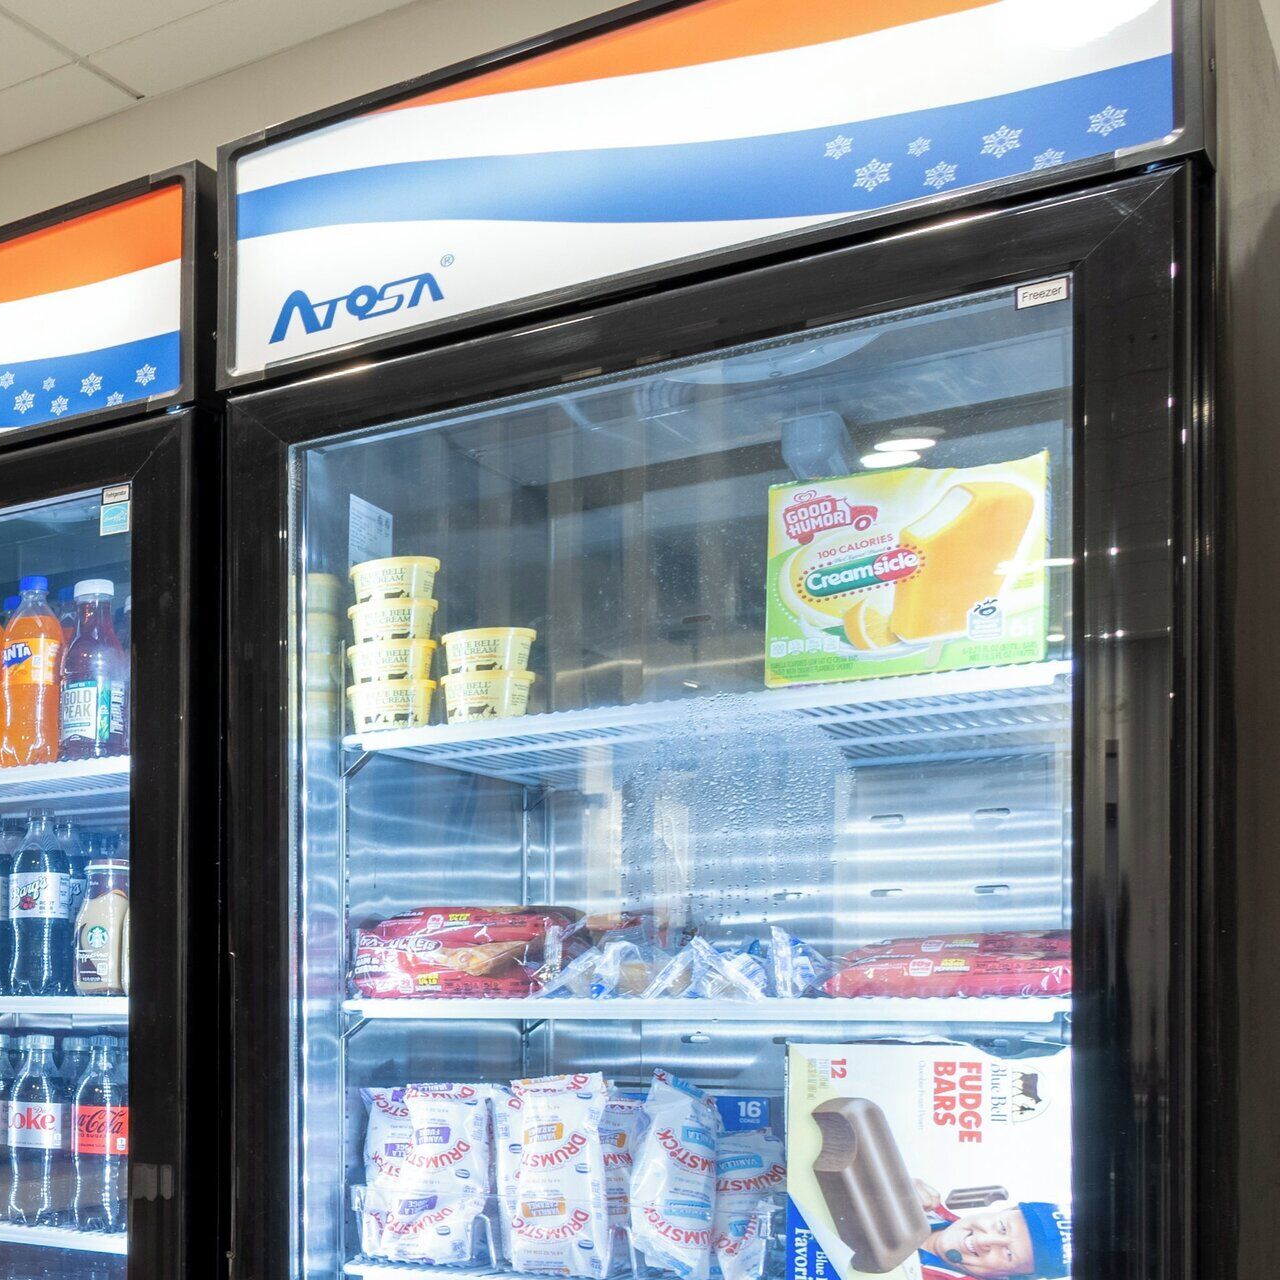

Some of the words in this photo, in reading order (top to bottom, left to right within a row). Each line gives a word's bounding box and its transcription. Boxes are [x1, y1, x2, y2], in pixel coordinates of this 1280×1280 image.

[1021, 284, 1062, 303] Freezer
[786, 499, 832, 525] GOOD
[788, 508, 845, 538] HUMOR
[817, 547, 838, 559] 100
[839, 533, 894, 555] CALORIES
[806, 549, 919, 591] Creamsicle
[63, 688, 92, 705] GOLD
[63, 703, 91, 719] PEAK
[830, 1058, 847, 1079] 12
[933, 1060, 956, 1126] BARS
[958, 1062, 983, 1144] FUDGE
[738, 1100, 762, 1119] 16
[990, 1094, 1008, 1122] Bell
[815, 1251, 830, 1274] Blue
